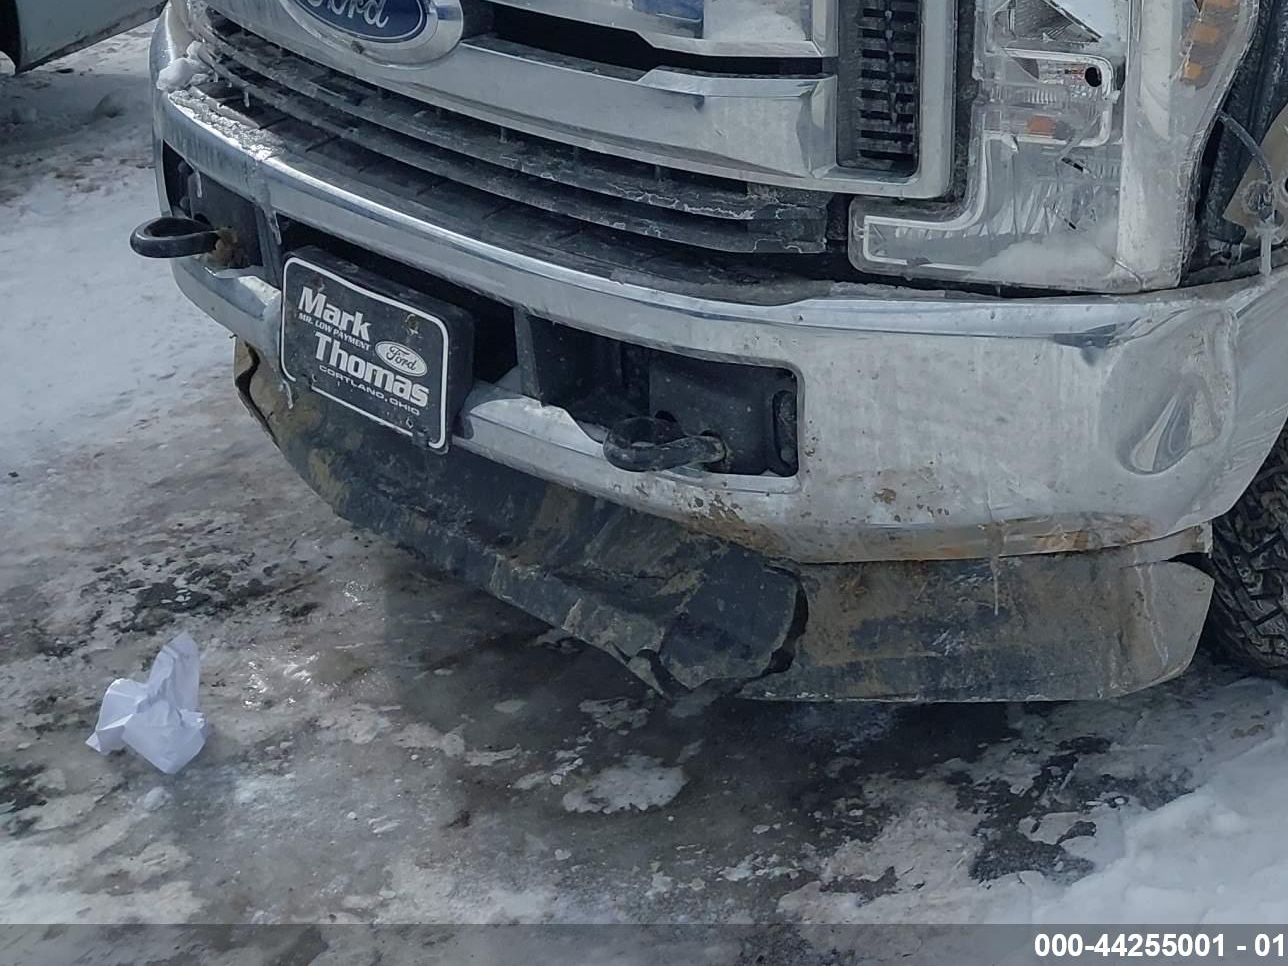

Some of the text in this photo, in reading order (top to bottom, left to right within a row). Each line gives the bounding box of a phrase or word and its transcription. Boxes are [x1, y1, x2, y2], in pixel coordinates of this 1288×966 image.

[298, 286, 372, 342] Mark
[298, 313, 371, 351] MR. LOW PAYMENT
[315, 331, 429, 408] Thomas
[386, 345, 416, 371] Ford
